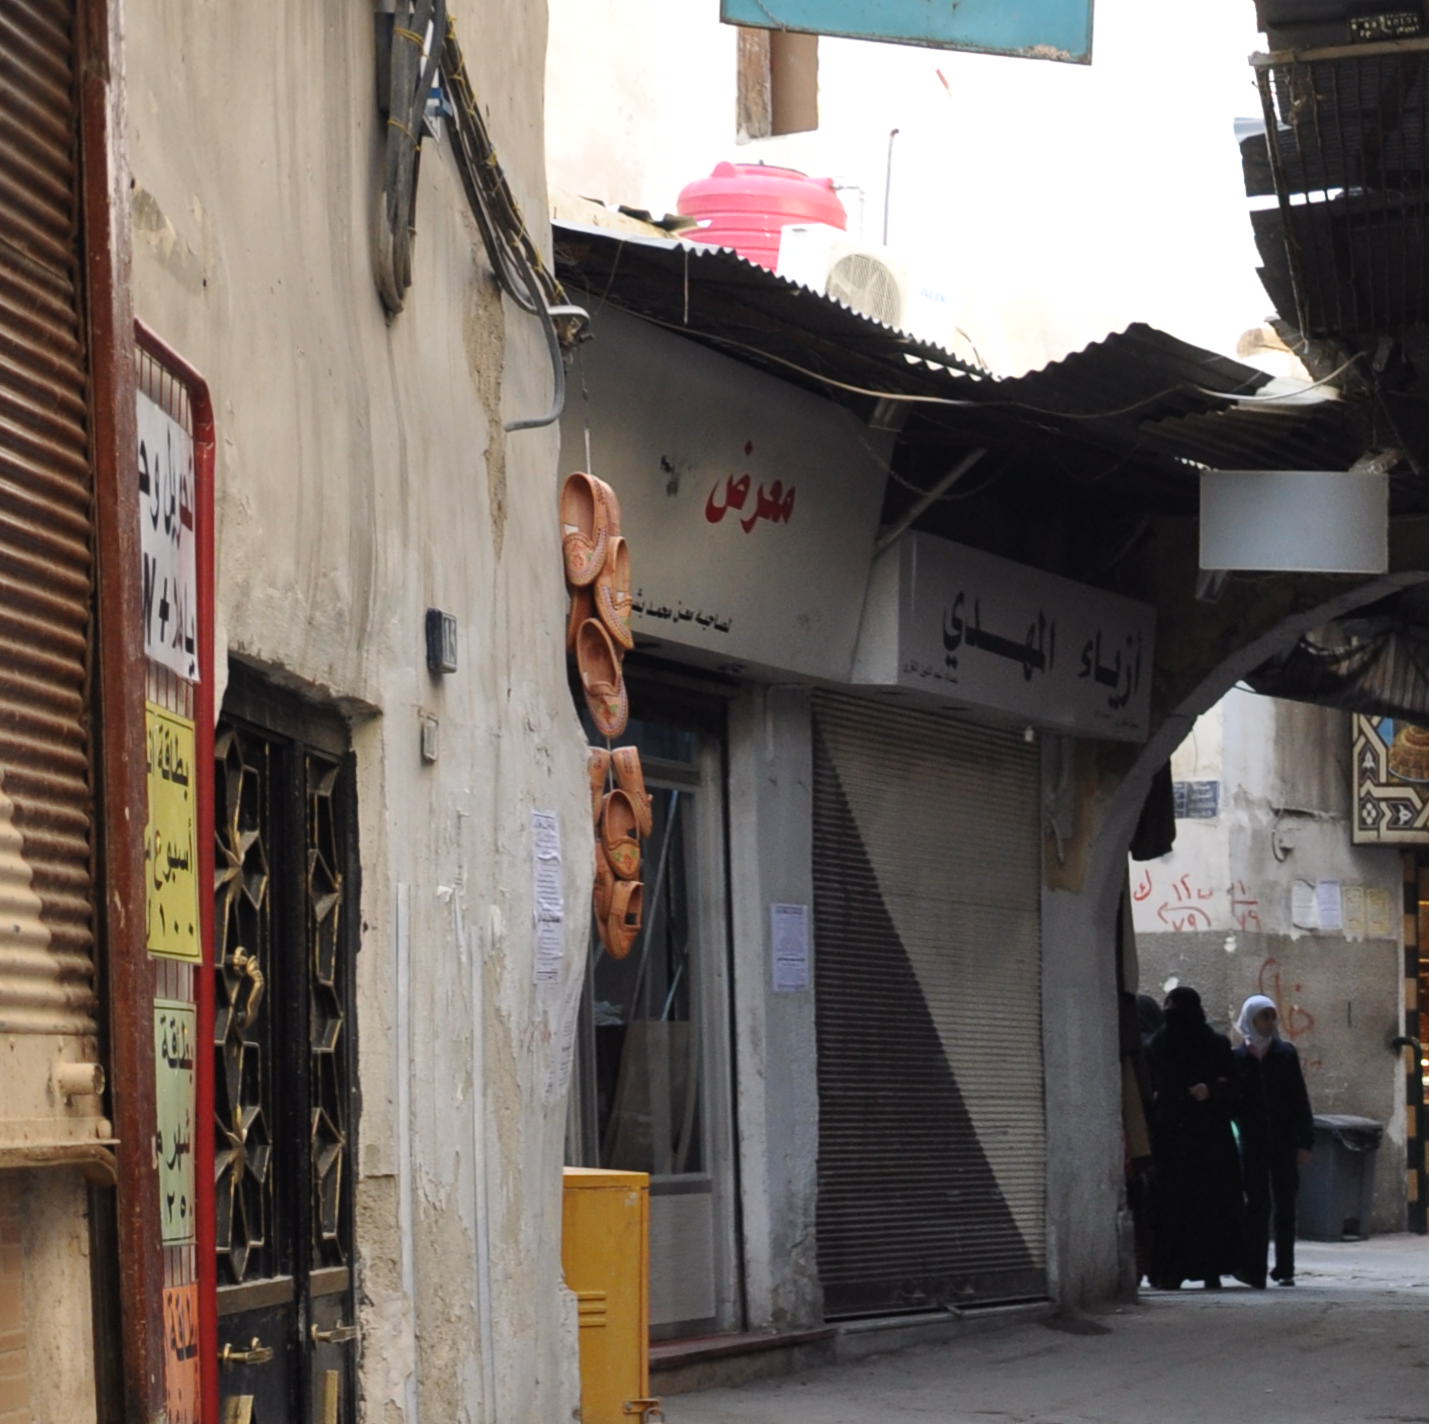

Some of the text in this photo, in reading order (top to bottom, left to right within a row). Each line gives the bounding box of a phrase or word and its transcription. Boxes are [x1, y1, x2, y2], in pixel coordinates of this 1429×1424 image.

[704, 439, 797, 534] معرض
[942, 588, 1143, 710] أزياء المهدي
[157, 723, 189, 801] بطاقة
[160, 1014, 194, 1085] بطاقة
